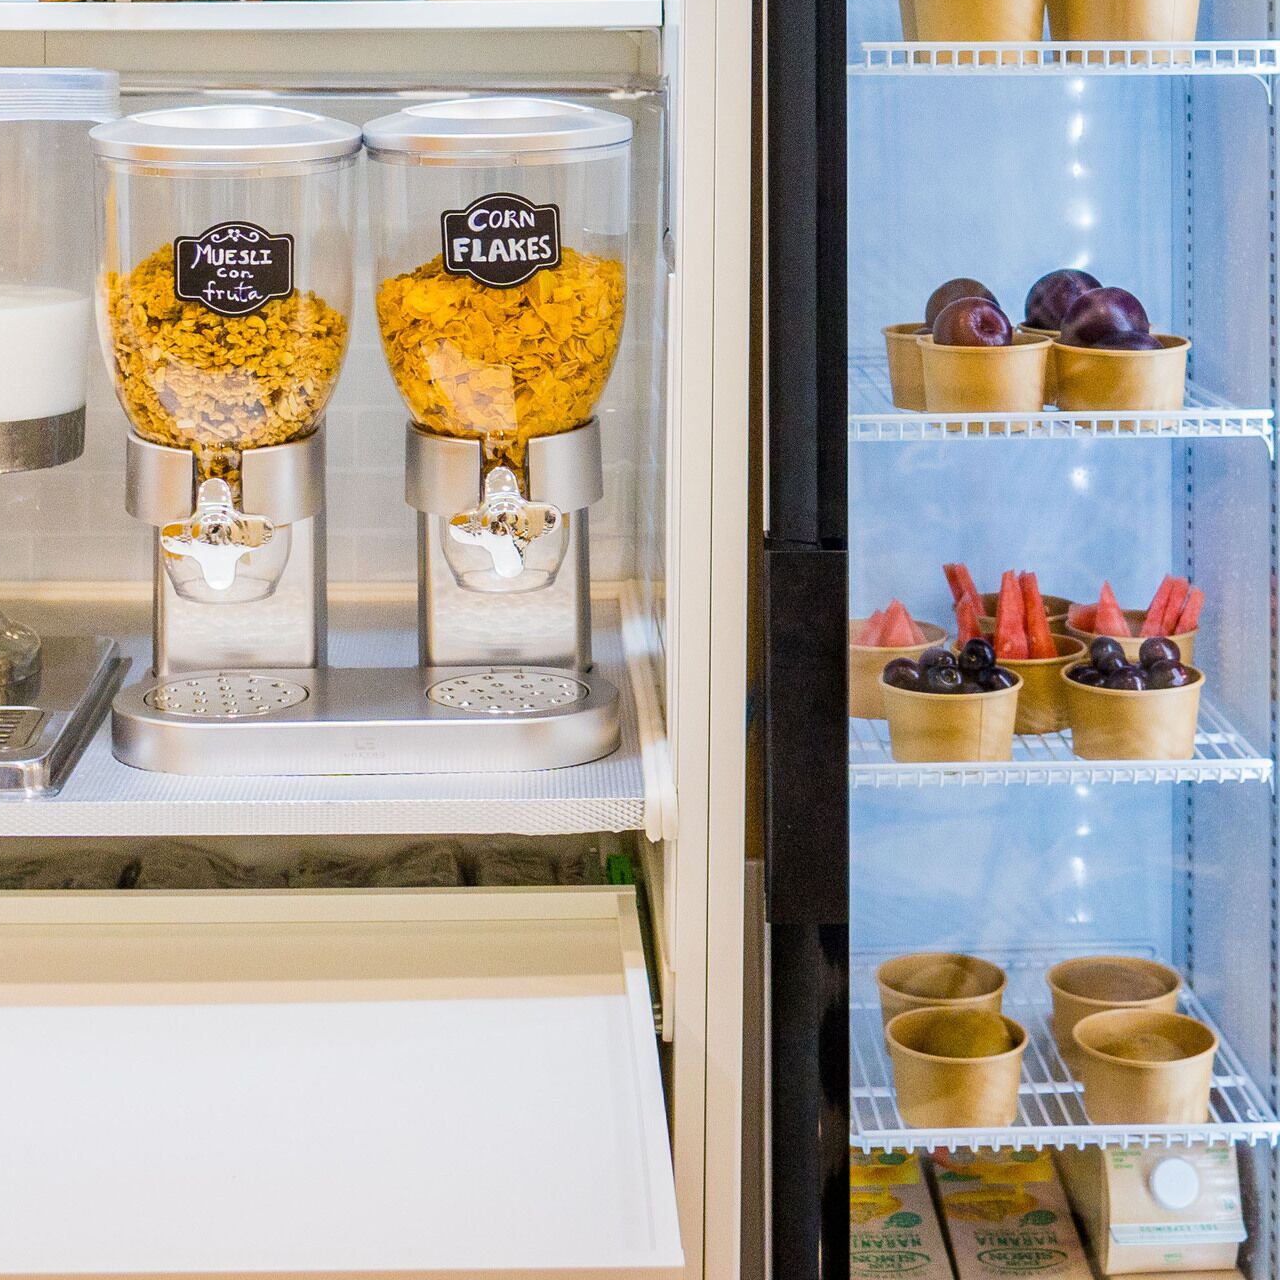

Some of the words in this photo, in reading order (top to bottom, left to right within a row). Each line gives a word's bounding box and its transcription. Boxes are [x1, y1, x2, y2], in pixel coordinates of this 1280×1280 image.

[467, 208, 535, 232] CORN
[190, 243, 273, 270] MUESLI
[452, 234, 552, 263] FLAKES
[216, 267, 254, 279] con
[202, 280, 263, 302] fruta
